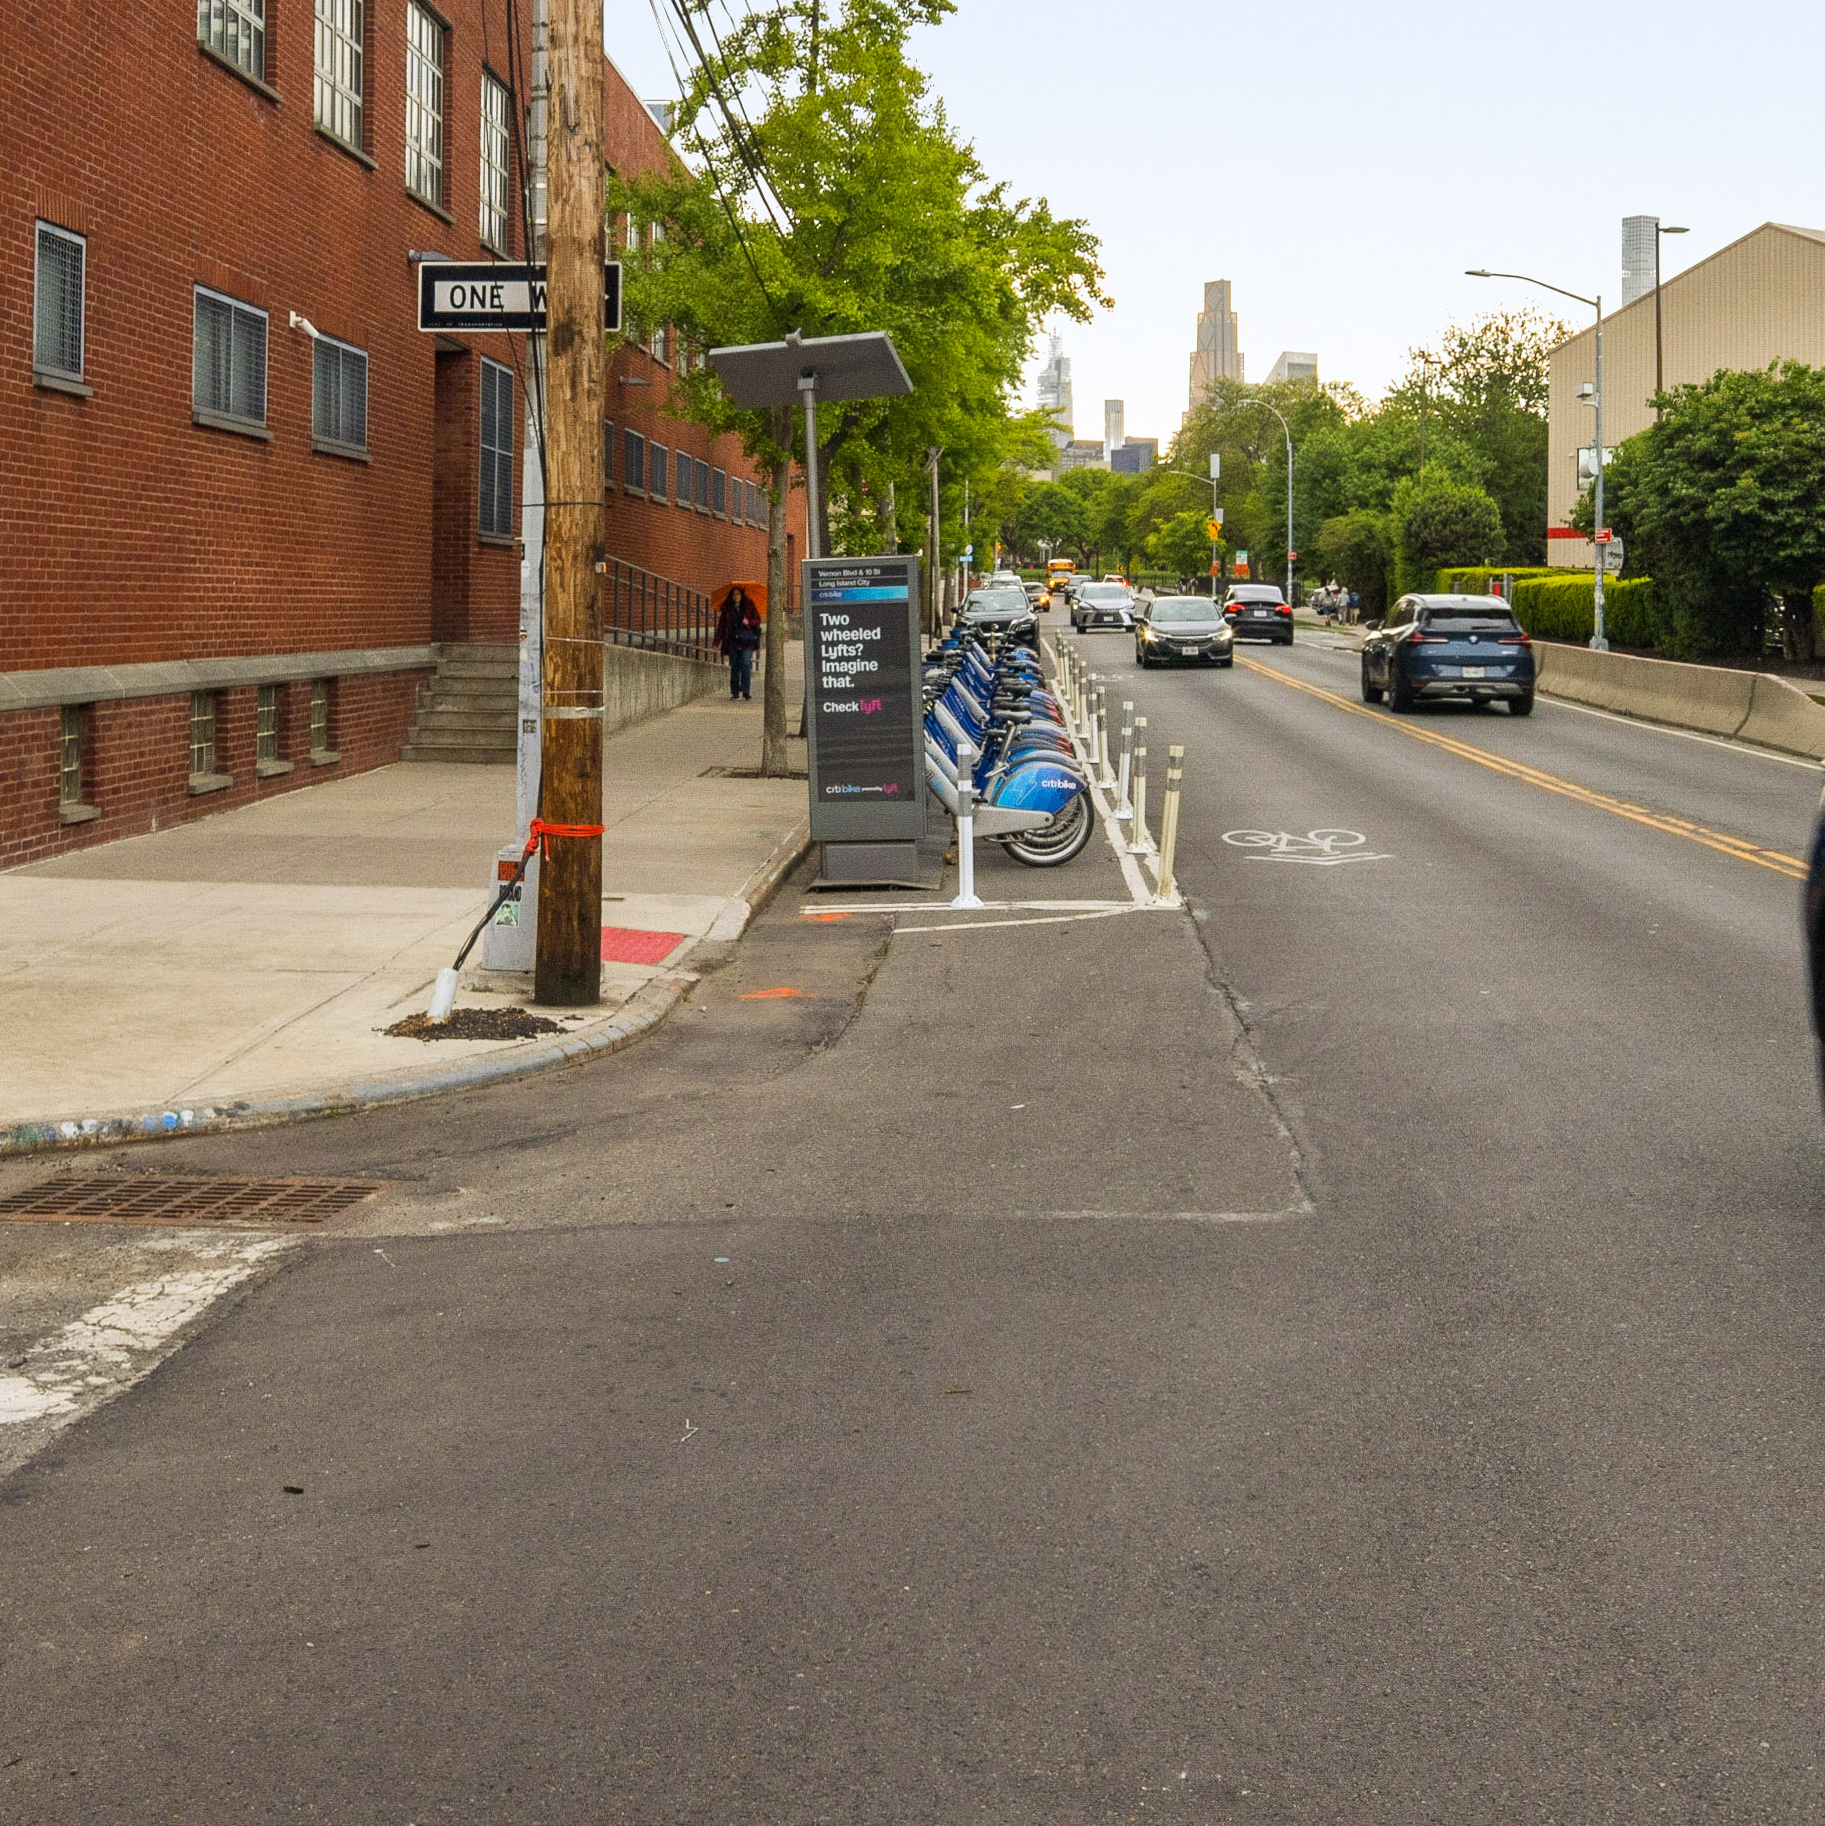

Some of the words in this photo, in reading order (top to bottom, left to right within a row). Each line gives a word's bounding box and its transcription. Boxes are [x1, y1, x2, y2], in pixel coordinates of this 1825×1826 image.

[449, 284, 505, 310] ONE
[818, 569, 842, 577] Vernon
[818, 580, 836, 588] Long
[857, 578, 871, 587] City
[819, 613, 850, 626] Two
[820, 627, 881, 641] wheeled
[821, 643, 864, 659] Lyfts?
[821, 659, 879, 674] Imagine
[822, 675, 855, 688] that.
[823, 701, 859, 713] Check
[860, 699, 882, 714] lyft
